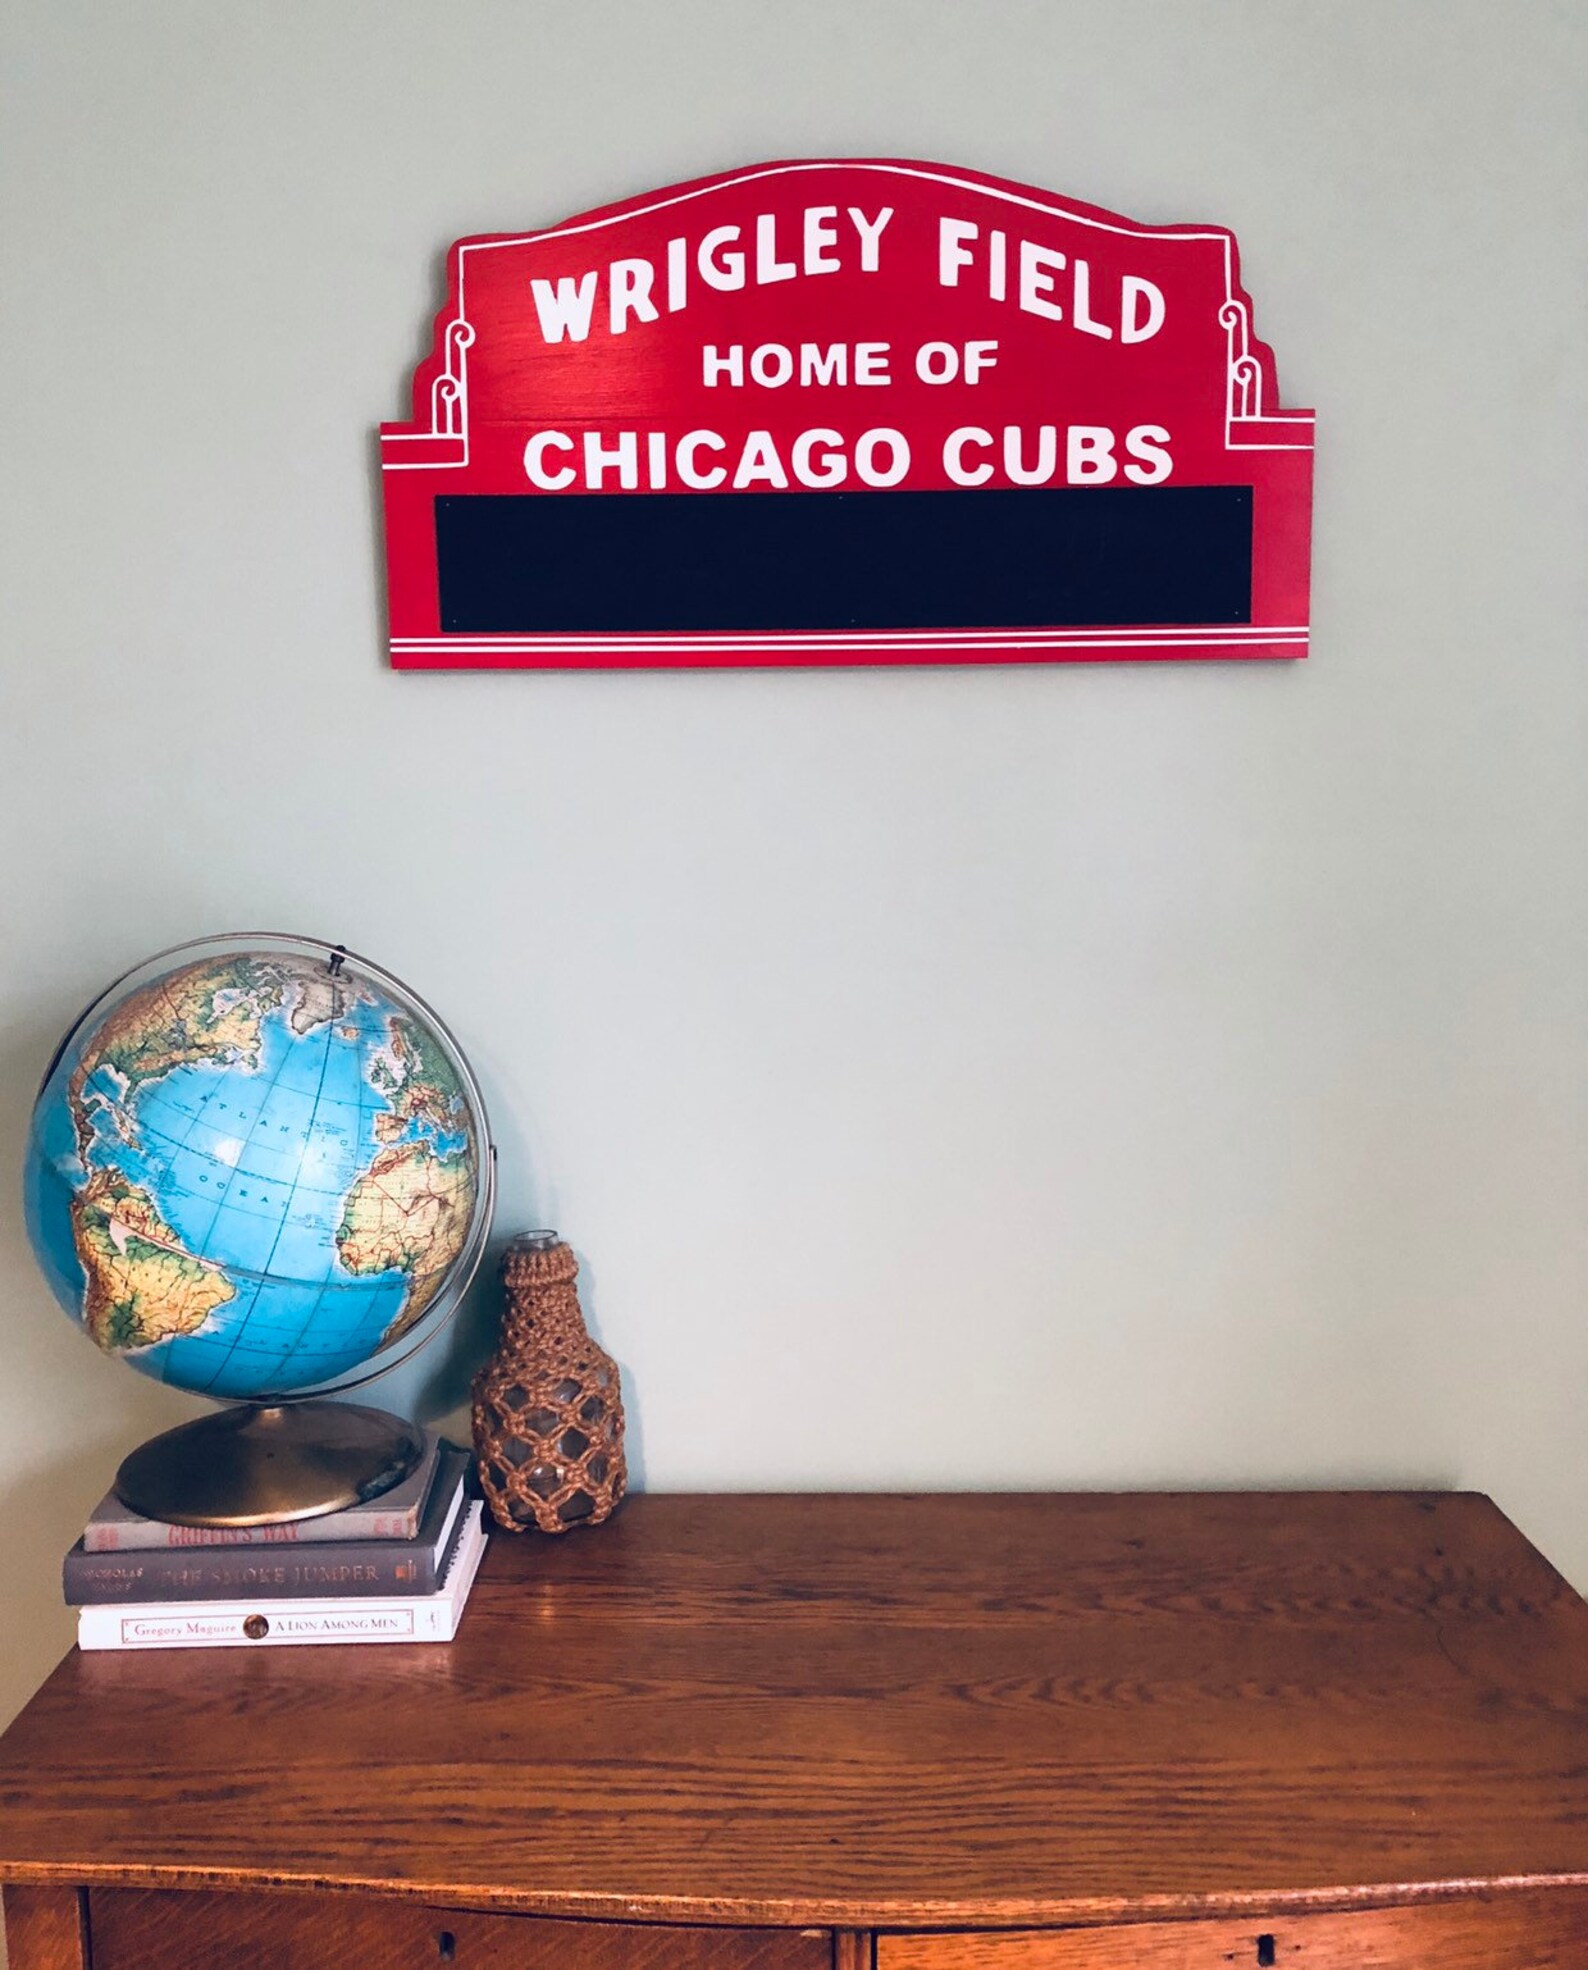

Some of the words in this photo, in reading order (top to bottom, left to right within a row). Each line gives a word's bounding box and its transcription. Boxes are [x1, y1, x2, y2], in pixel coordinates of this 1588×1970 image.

[530, 206, 894, 344] WRIGLEY
[939, 217, 1166, 344] FIELD
[703, 341, 891, 388] HOME
[915, 340, 998, 386] OF
[523, 427, 911, 490] CHICAGO
[943, 425, 1173, 486] CUBS
[210, 1567, 286, 1585] SMOKE
[294, 1564, 380, 1583] JUMPER
[134, 1623, 182, 1636] Gregory
[186, 1622, 237, 1634] Maguire
[275, 1620, 285, 1631] A
